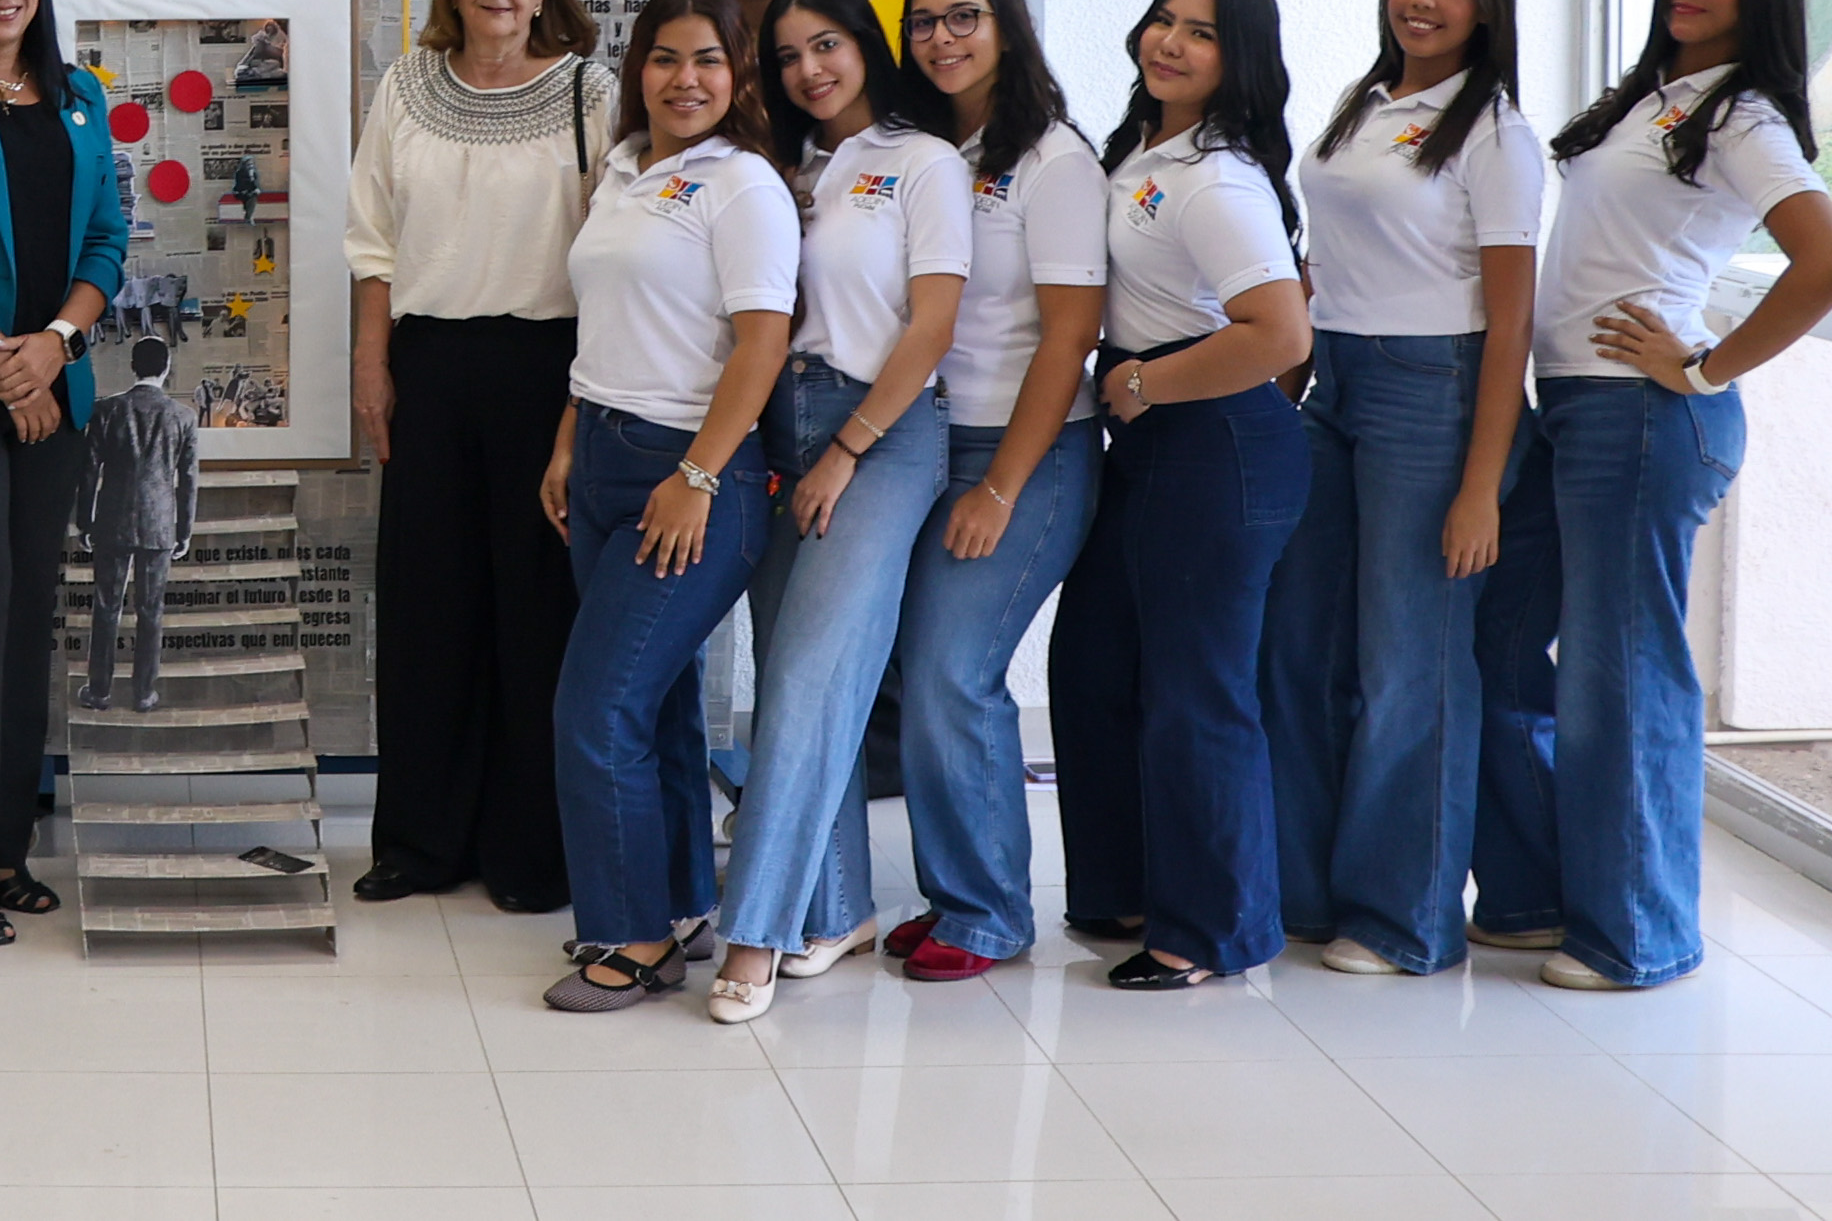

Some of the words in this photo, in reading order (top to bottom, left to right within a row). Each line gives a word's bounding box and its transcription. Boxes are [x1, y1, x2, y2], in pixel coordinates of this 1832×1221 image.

[195, 548, 221, 563] que
[316, 545, 351, 561] cada
[226, 589, 239, 604] el
[243, 588, 286, 604] futuro
[299, 588, 333, 605] esde
[337, 588, 351, 604] la
[241, 632, 267, 648] que
